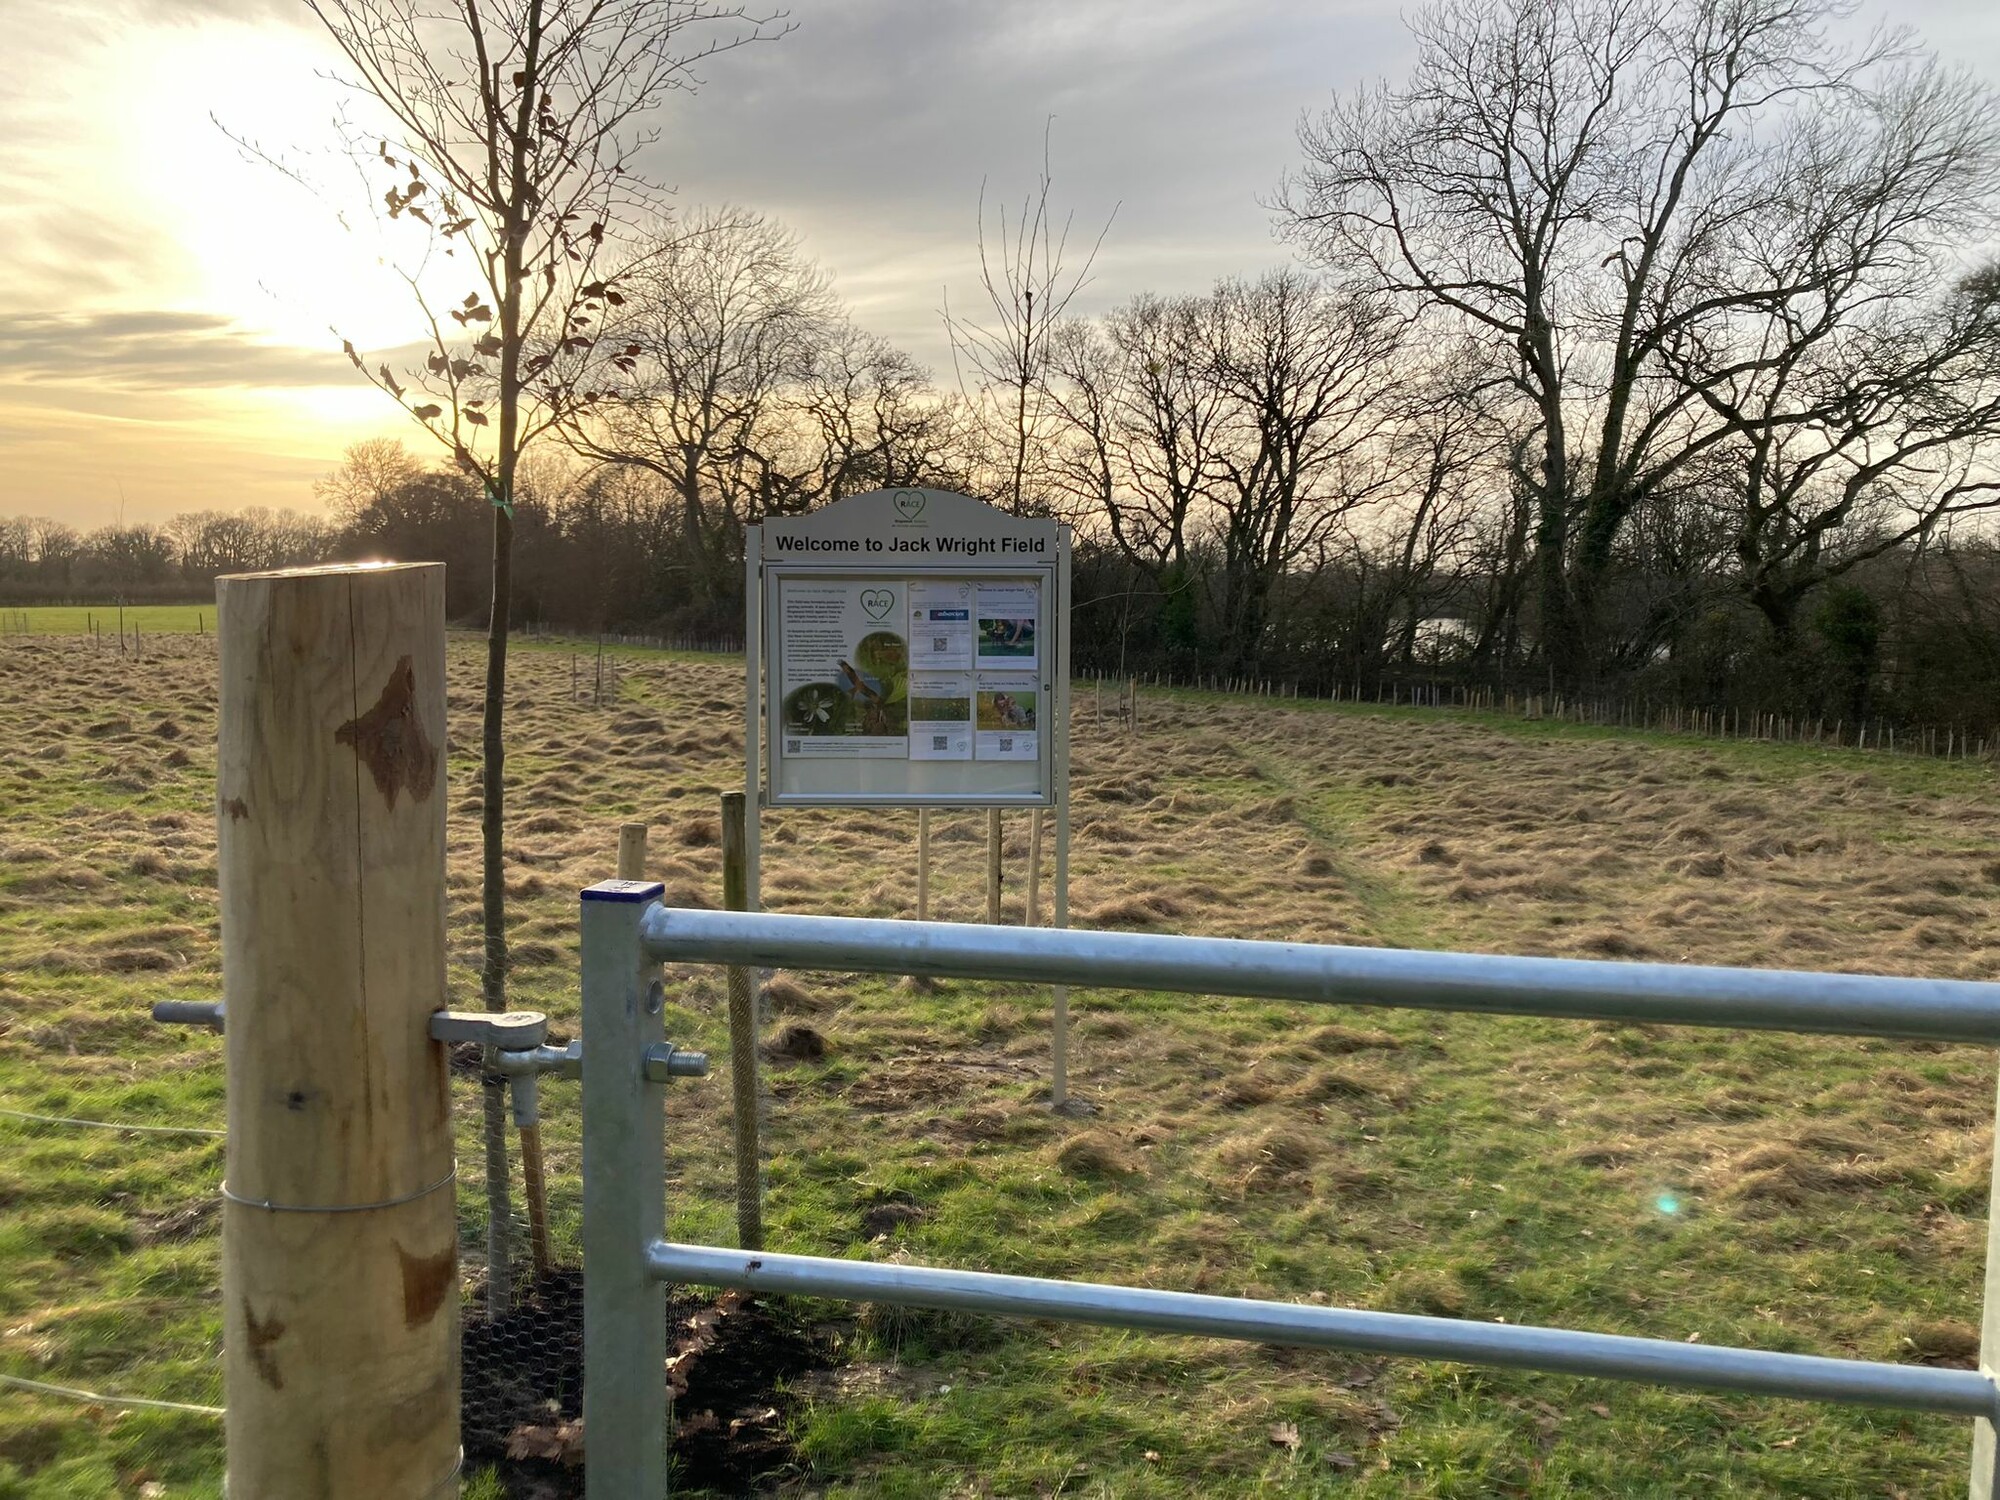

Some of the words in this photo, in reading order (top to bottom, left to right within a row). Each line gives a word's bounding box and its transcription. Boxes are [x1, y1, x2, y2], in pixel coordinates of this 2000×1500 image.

[776, 536, 860, 552] Welcome
[865, 537, 883, 552] to
[888, 537, 931, 552] Jack
[936, 537, 996, 556] Wright
[1001, 537, 1045, 553] Field
[867, 599, 889, 608] RACE
